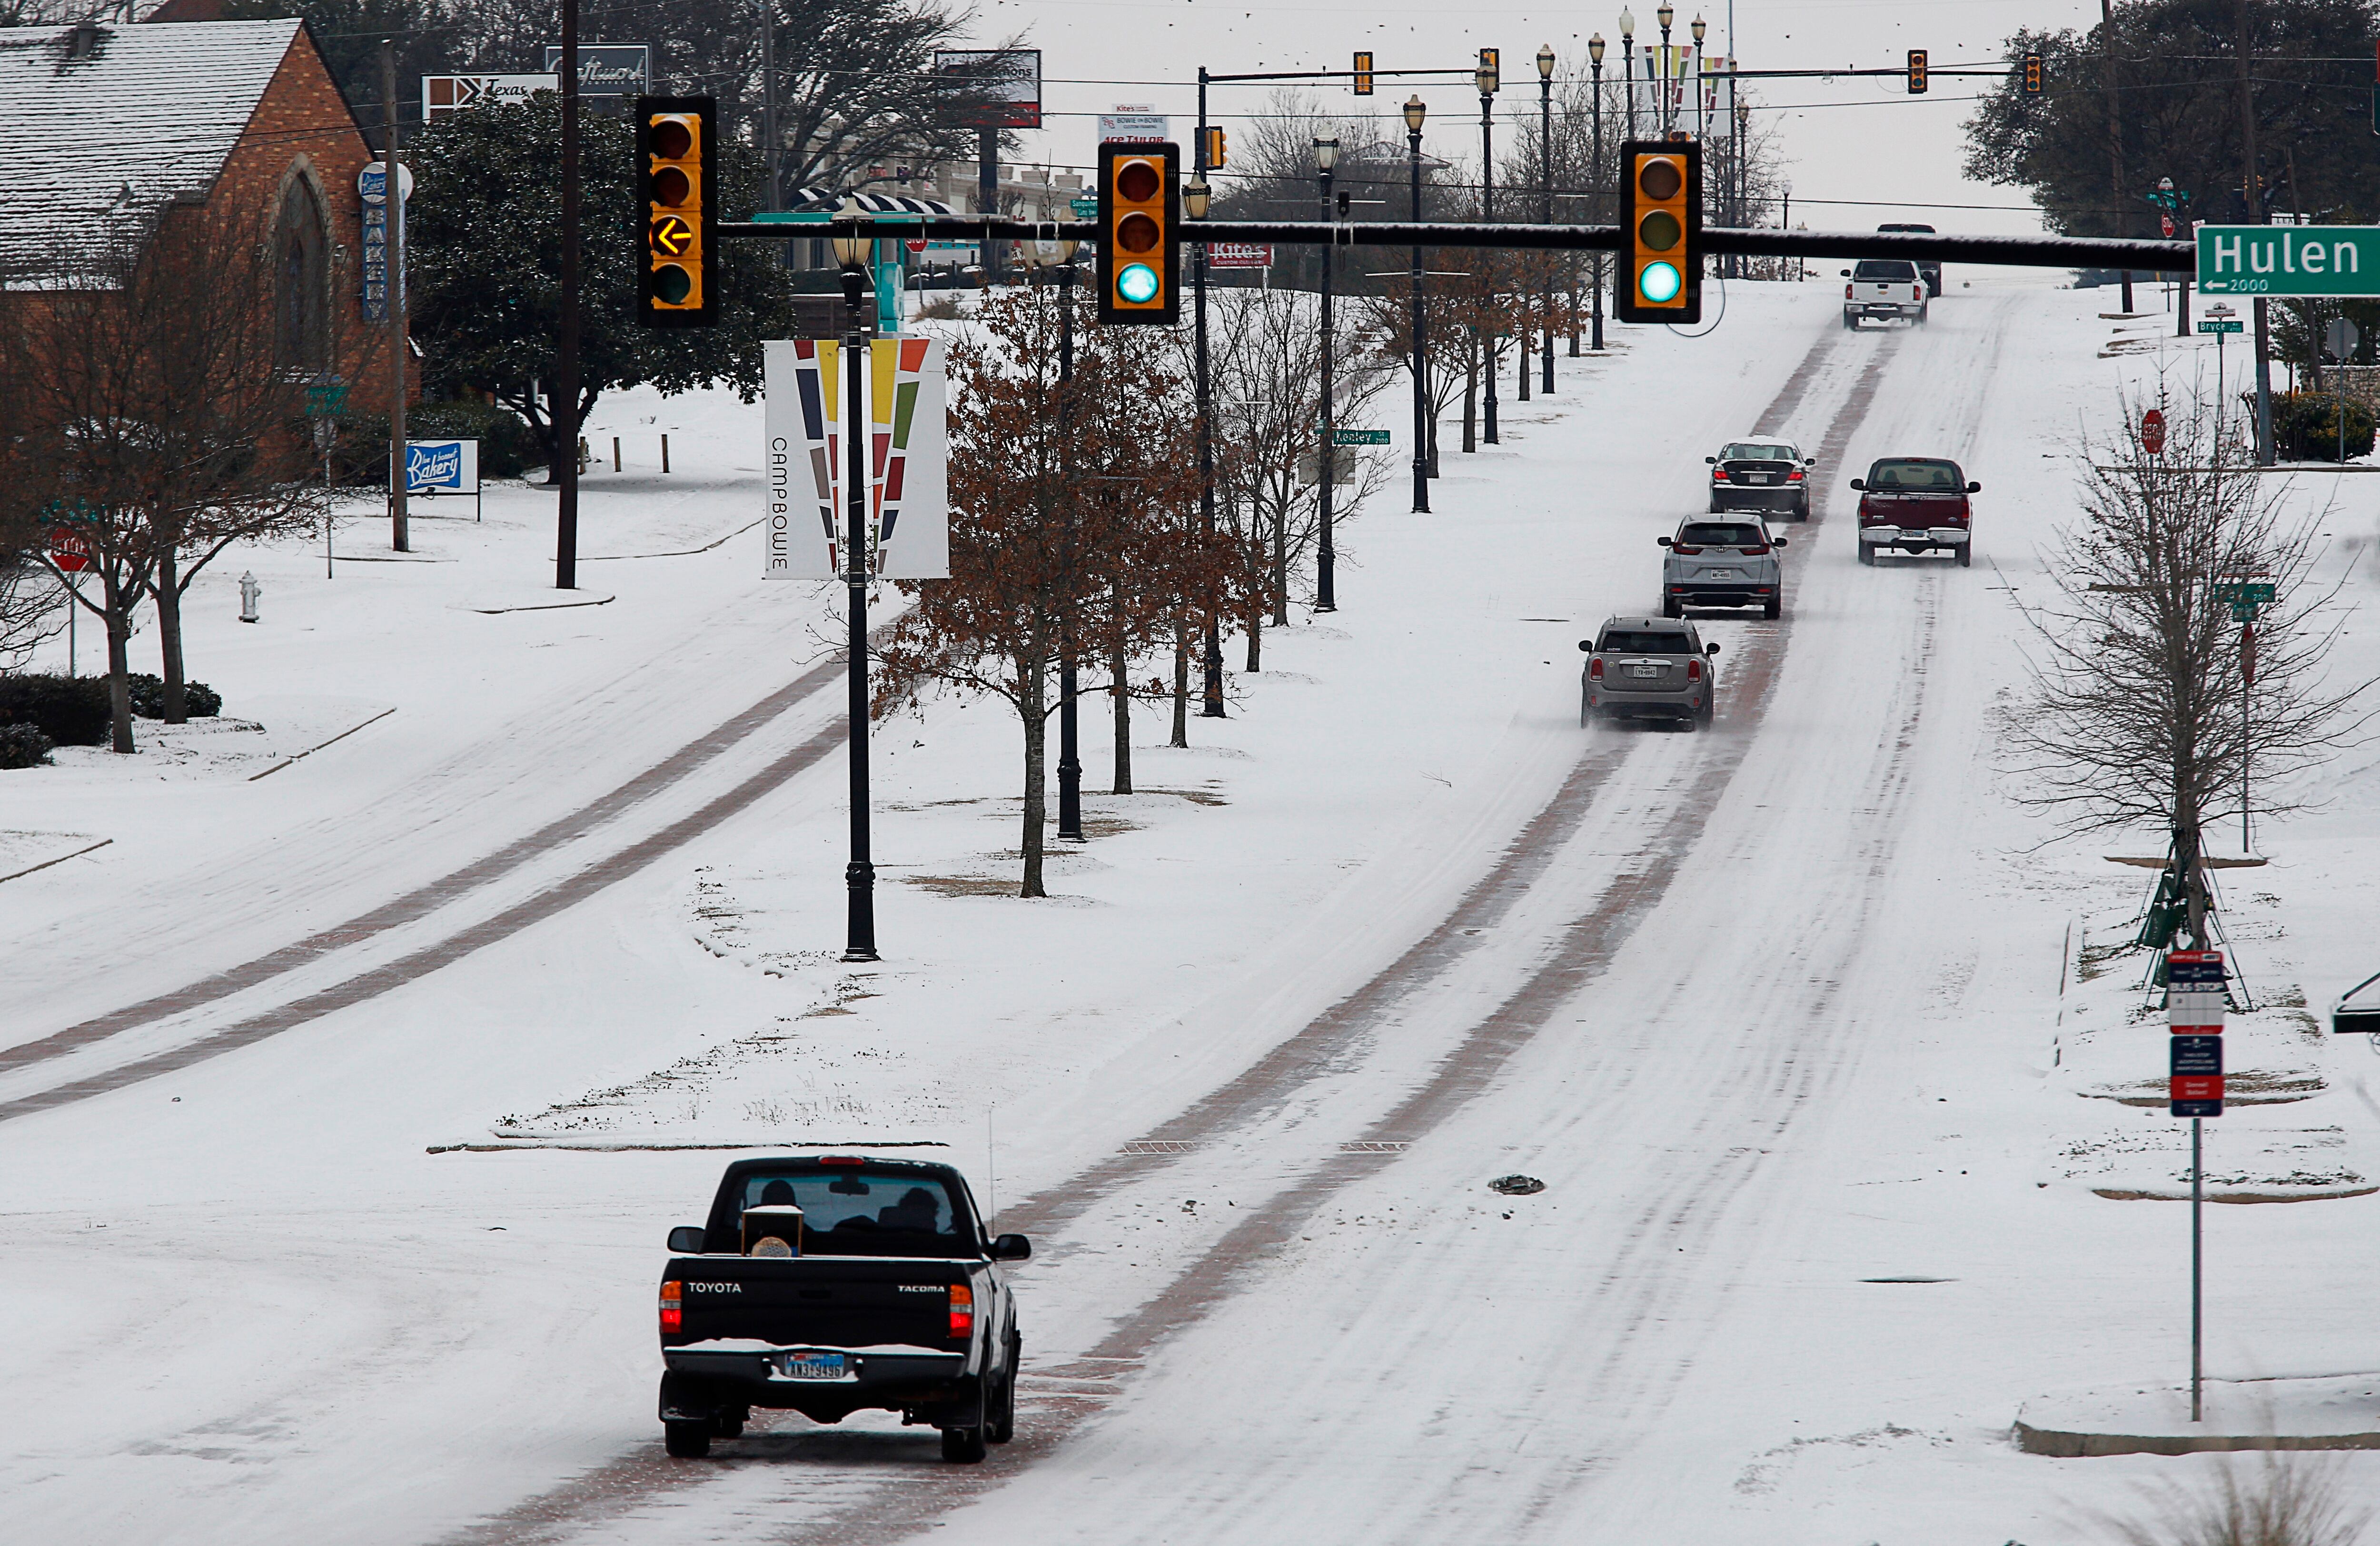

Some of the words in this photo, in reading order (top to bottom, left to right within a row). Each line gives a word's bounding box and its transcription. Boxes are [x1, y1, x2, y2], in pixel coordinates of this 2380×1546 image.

[485, 78, 527, 96] Texas
[366, 209, 385, 319] BAKERY
[2215, 232, 2358, 273] Hulen
[2230, 279, 2269, 291] 2000
[2201, 322, 2225, 331] Bryce
[407, 448, 458, 487] Bakery
[772, 437, 787, 499] CAMP
[772, 503, 787, 569] BOWIE
[2170, 983, 2192, 991] BUS
[2194, 983, 2224, 991] STOP
[688, 1282, 742, 1293] TOYOTA
